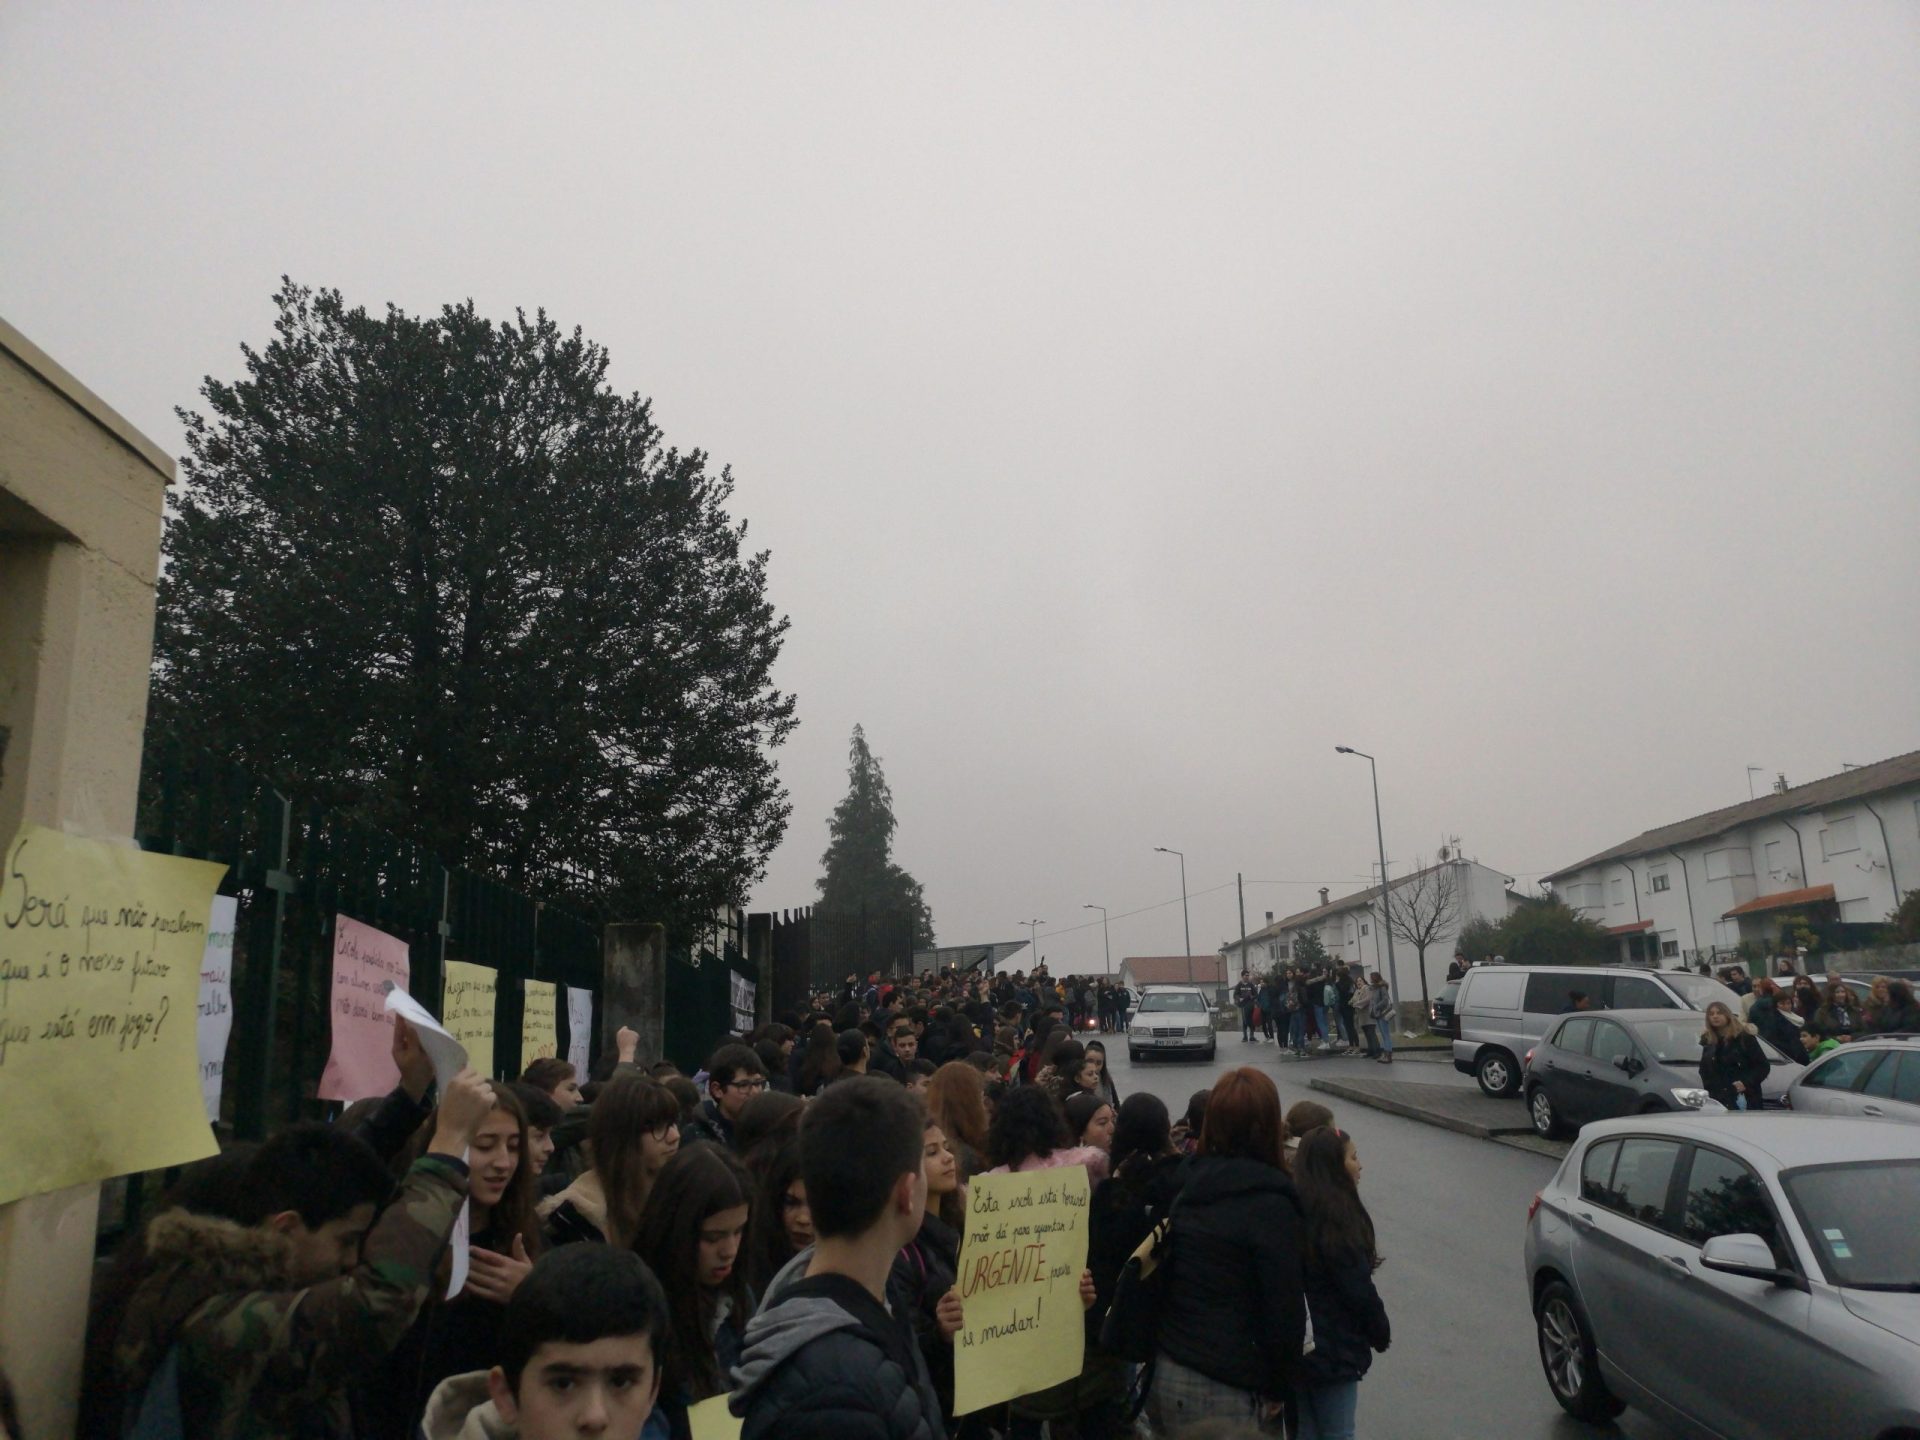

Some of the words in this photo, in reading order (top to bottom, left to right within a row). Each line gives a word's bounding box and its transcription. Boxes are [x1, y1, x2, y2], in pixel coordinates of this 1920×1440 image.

[4, 839, 69, 929] Será
[80, 905, 108, 954] que
[115, 901, 147, 928] não
[1, 959, 29, 1008] que
[88, 1014, 116, 1039] em
[119, 996, 170, 1051] jogo?
[973, 1186, 999, 1213] Esta
[1008, 1187, 1033, 1210] escola
[1038, 1186, 1058, 1206] está
[968, 1224, 990, 1247] não
[996, 1222, 1008, 1239] dá
[1013, 1224, 1030, 1244] para
[962, 1243, 1045, 1298] URGENTE
[980, 1296, 1041, 1345] mudar!
